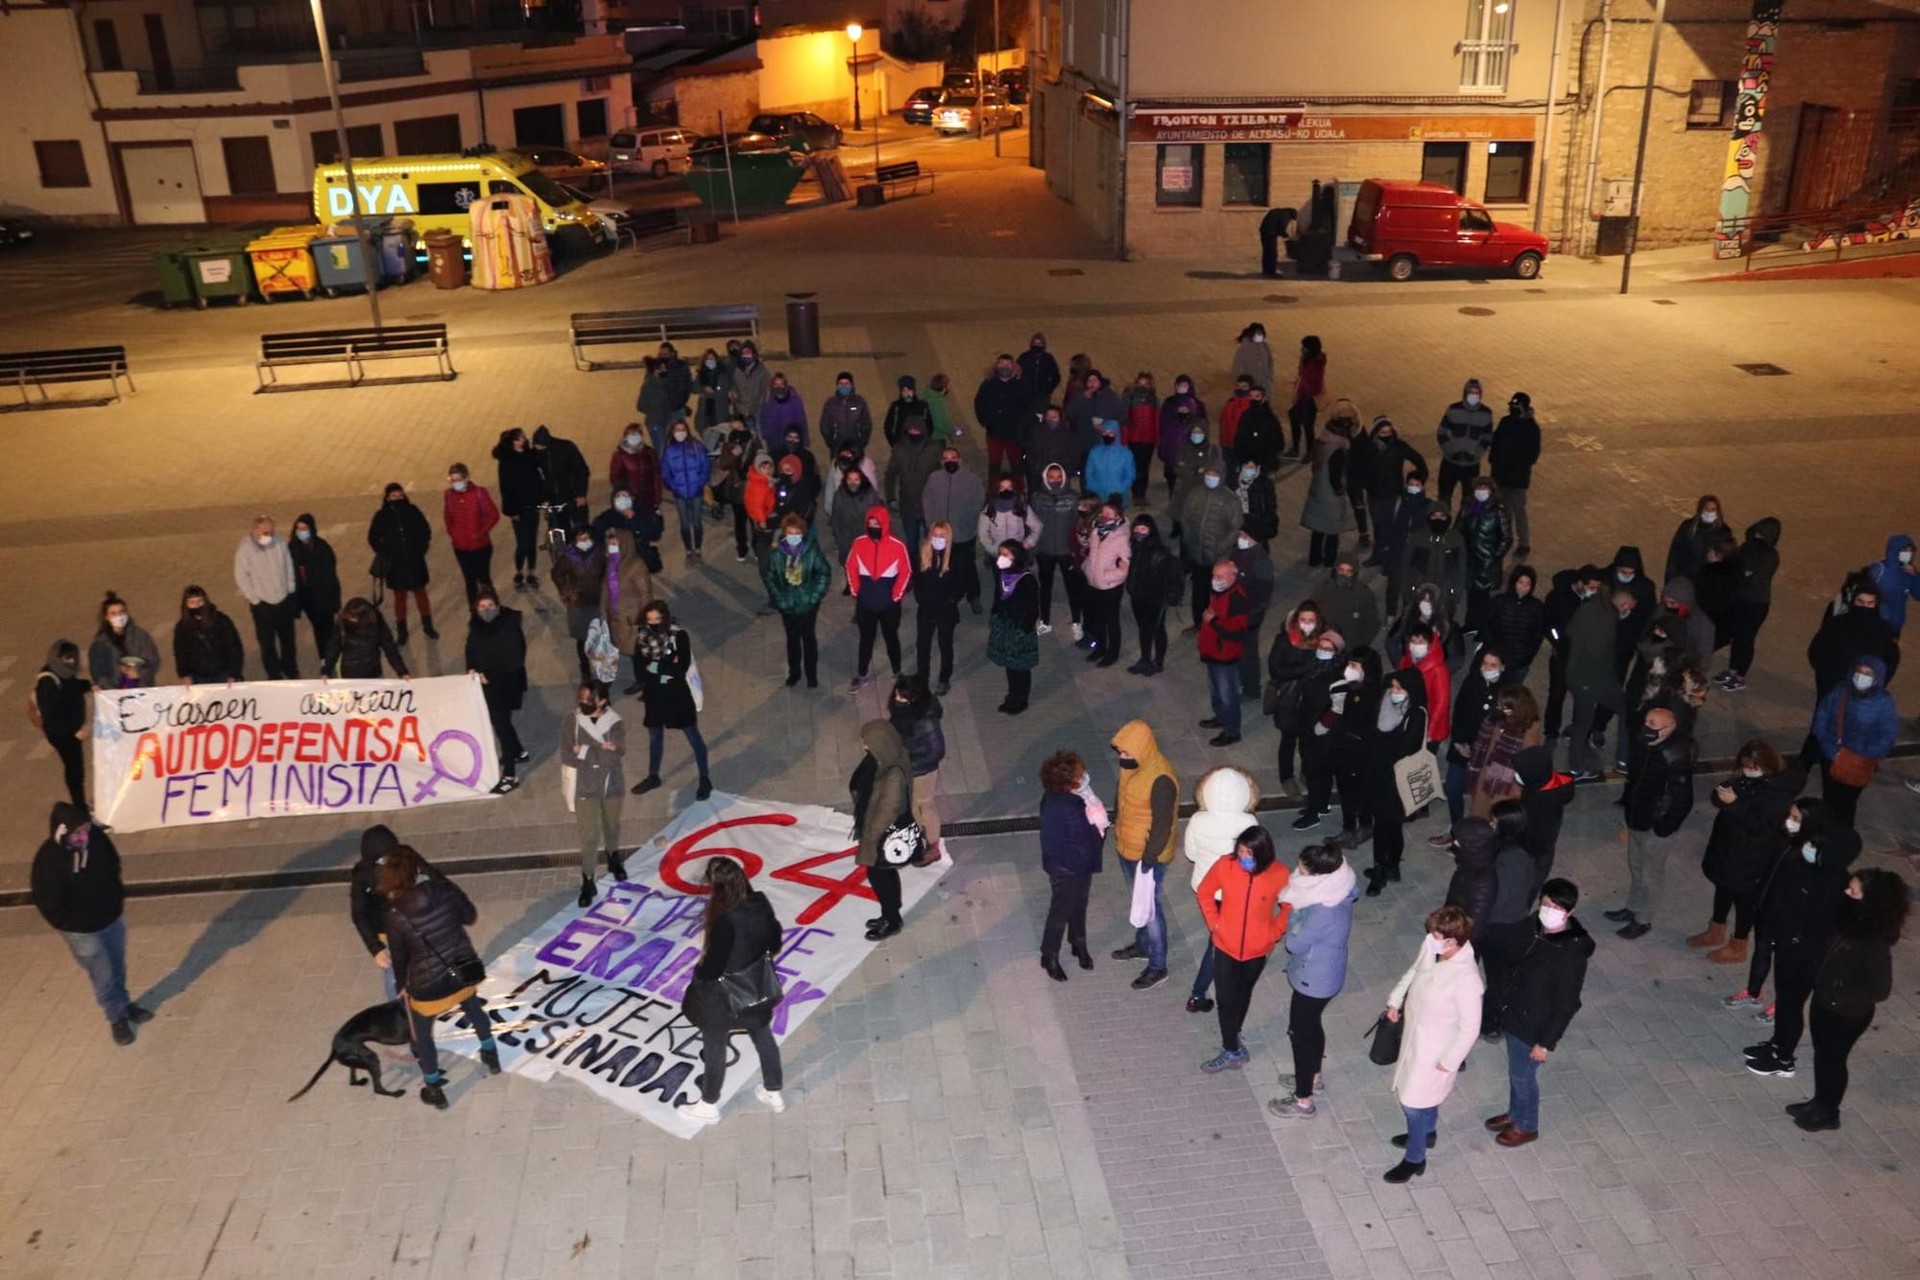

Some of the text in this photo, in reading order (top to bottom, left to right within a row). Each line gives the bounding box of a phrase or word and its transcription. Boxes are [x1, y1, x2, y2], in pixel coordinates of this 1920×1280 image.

[1153, 115, 1217, 126] FRONTON
[1156, 130, 1227, 140] AYUNTAMIENTO
[1231, 130, 1245, 139] DE
[1314, 129, 1345, 139] UDALA
[328, 184, 414, 217] DYA
[131, 715, 426, 780] AUTODEFENTSA
[161, 761, 407, 823] FEMINISTA
[659, 813, 880, 925] 64
